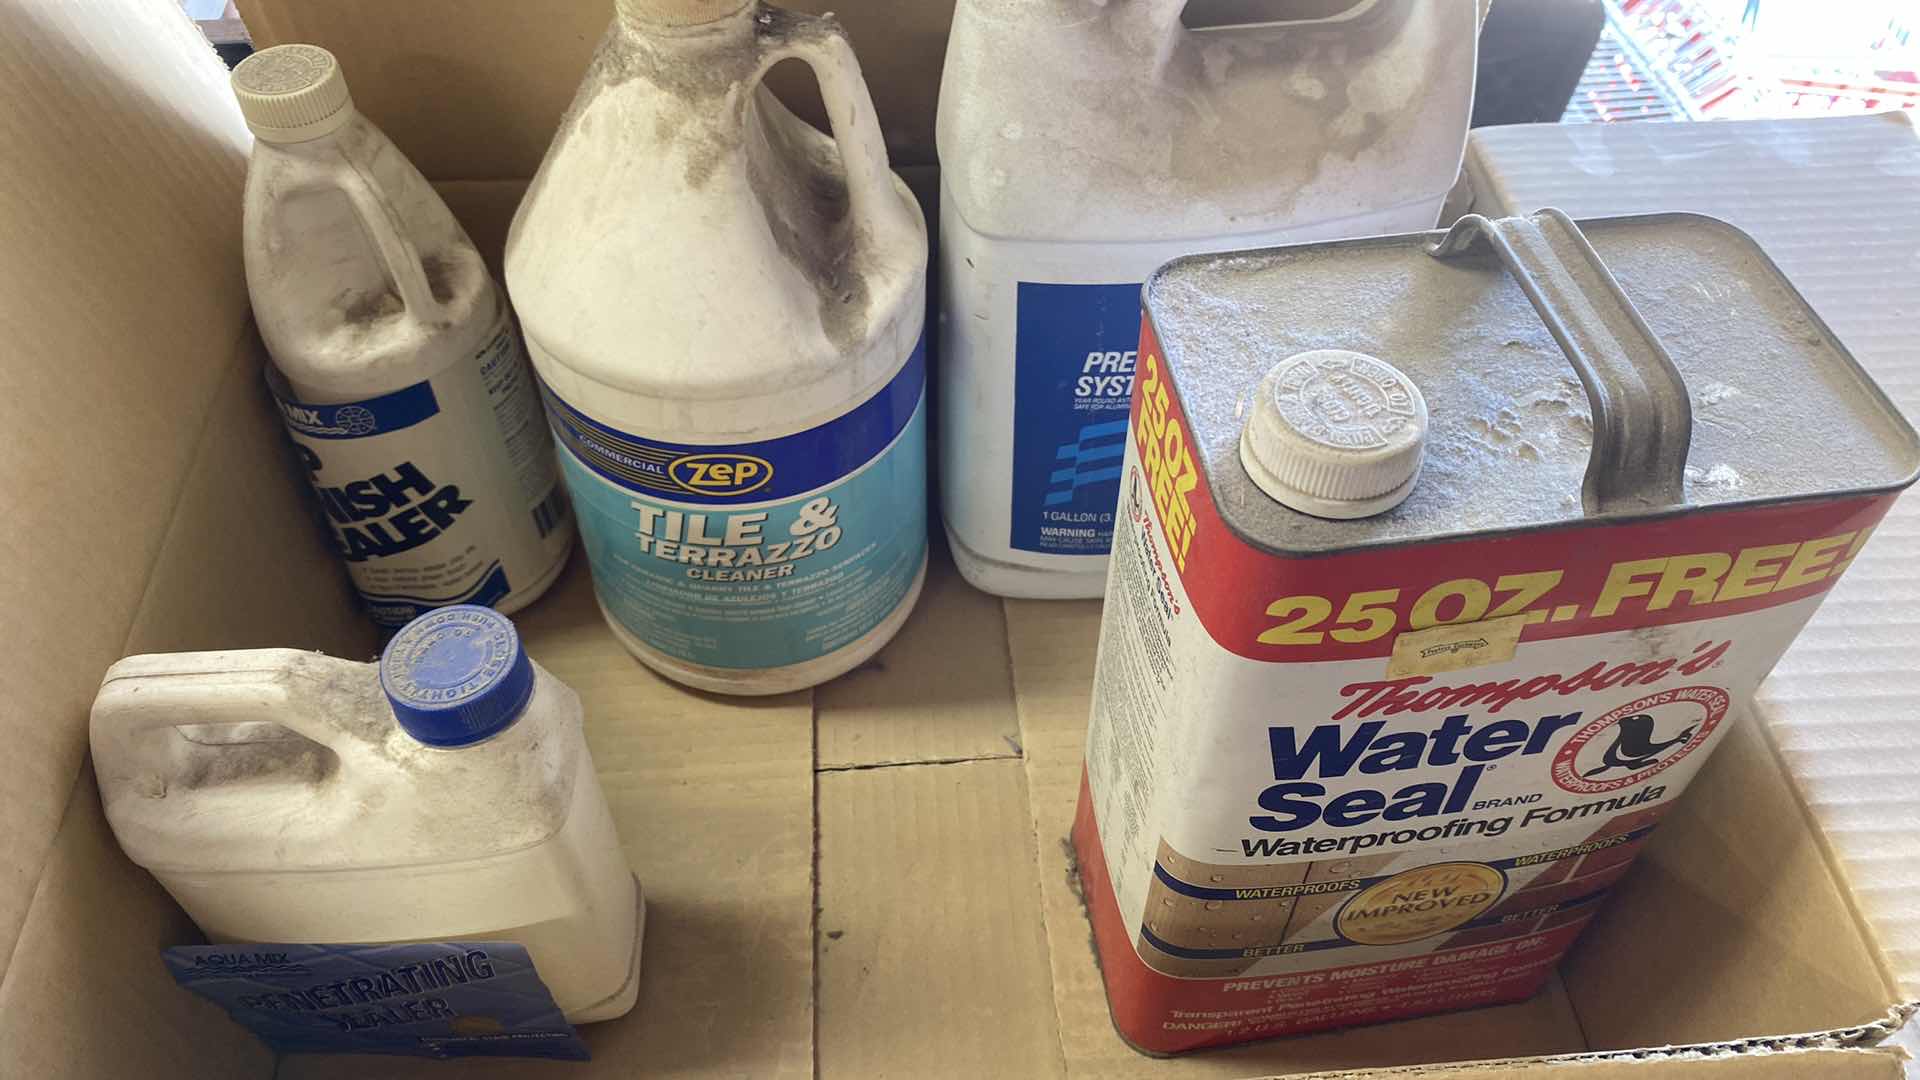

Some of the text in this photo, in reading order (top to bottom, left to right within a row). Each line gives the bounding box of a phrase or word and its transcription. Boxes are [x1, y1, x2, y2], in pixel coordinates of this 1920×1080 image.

[1082, 351, 1137, 373] PRE
[1142, 355, 1169, 439] 25
[579, 434, 664, 474] COMMERCIAL
[1137, 397, 1191, 573] FREE!
[631, 497, 839, 546] TILE &
[1040, 527, 1096, 537] WARNING
[1051, 511, 1097, 522] GALLON
[635, 526, 843, 567] TERRAZZO
[687, 564, 795, 582] CLEANER
[1256, 527, 1876, 645] 25 OZ. FREE!
[1332, 639, 1732, 720] Thompson's
[1676, 688, 1714, 702] WATER
[1268, 711, 1583, 781] Water
[1249, 764, 1543, 832] Seal BRAND
[1241, 784, 1667, 858] Waterproofing Formula
[1515, 833, 1630, 867] WATERPROOFS
[1235, 879, 1361, 900] WATERPROOFS
[1393, 885, 1460, 904] NEW
[1346, 892, 1490, 921] IMPROVED
[1502, 903, 1560, 922] BETTER
[1242, 944, 1305, 958] BETTER
[1223, 972, 1326, 992] PREVENTS
[1330, 957, 1429, 981] MOISTURE
[1432, 943, 1511, 967] DAMAGE
[1162, 1019, 1242, 1031] DANGER!
[1170, 1006, 1274, 1020] Transparent
